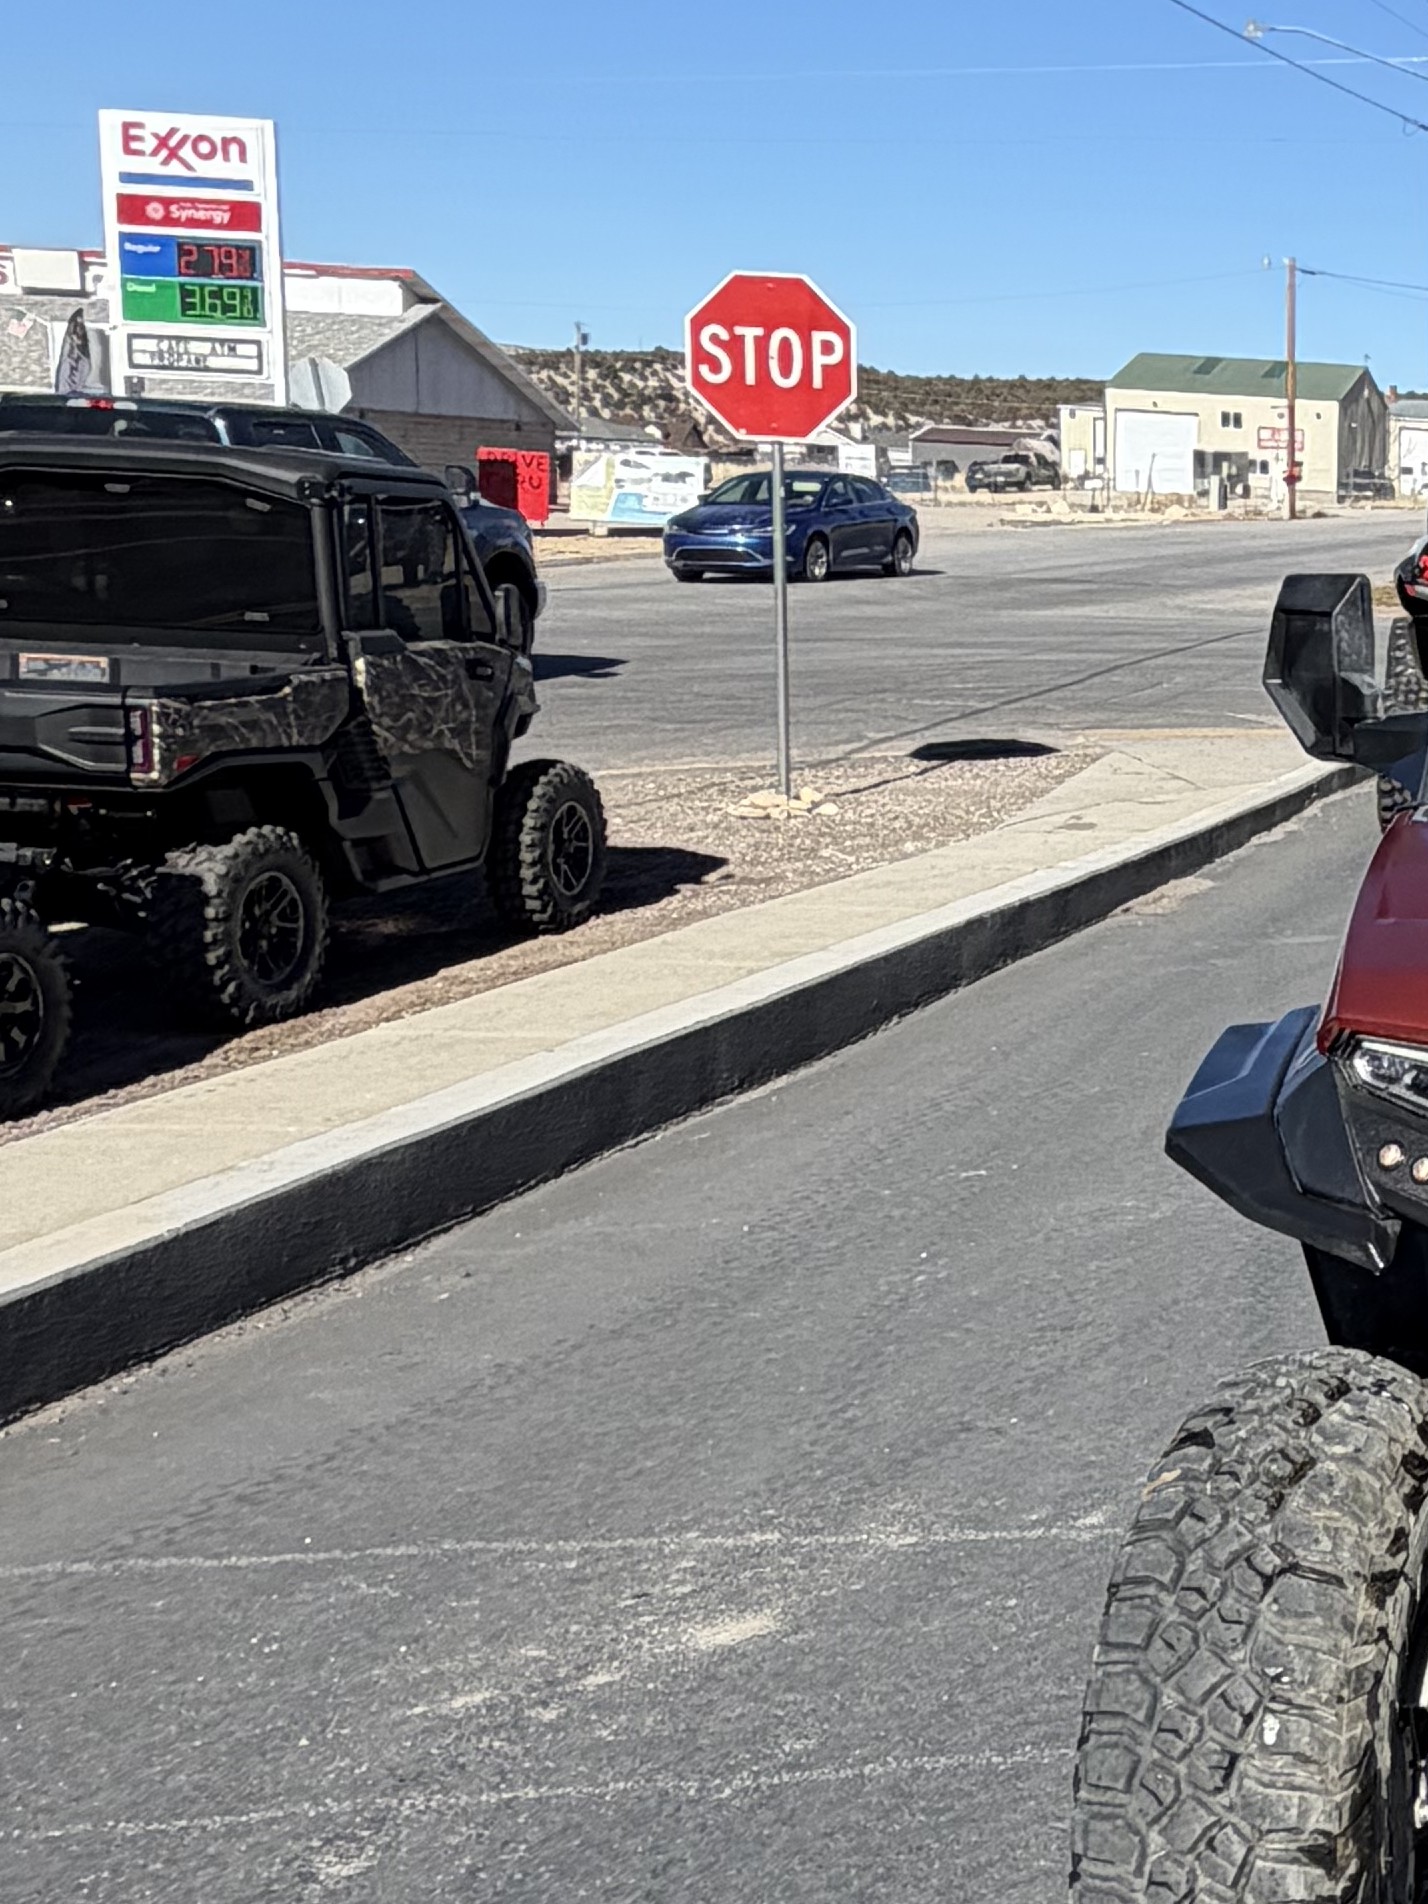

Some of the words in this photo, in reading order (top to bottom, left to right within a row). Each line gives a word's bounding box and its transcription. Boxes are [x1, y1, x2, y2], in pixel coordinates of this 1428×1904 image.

[121, 121, 248, 172] Exxon
[169, 204, 232, 224] Synergy
[698, 323, 844, 390] STOP
